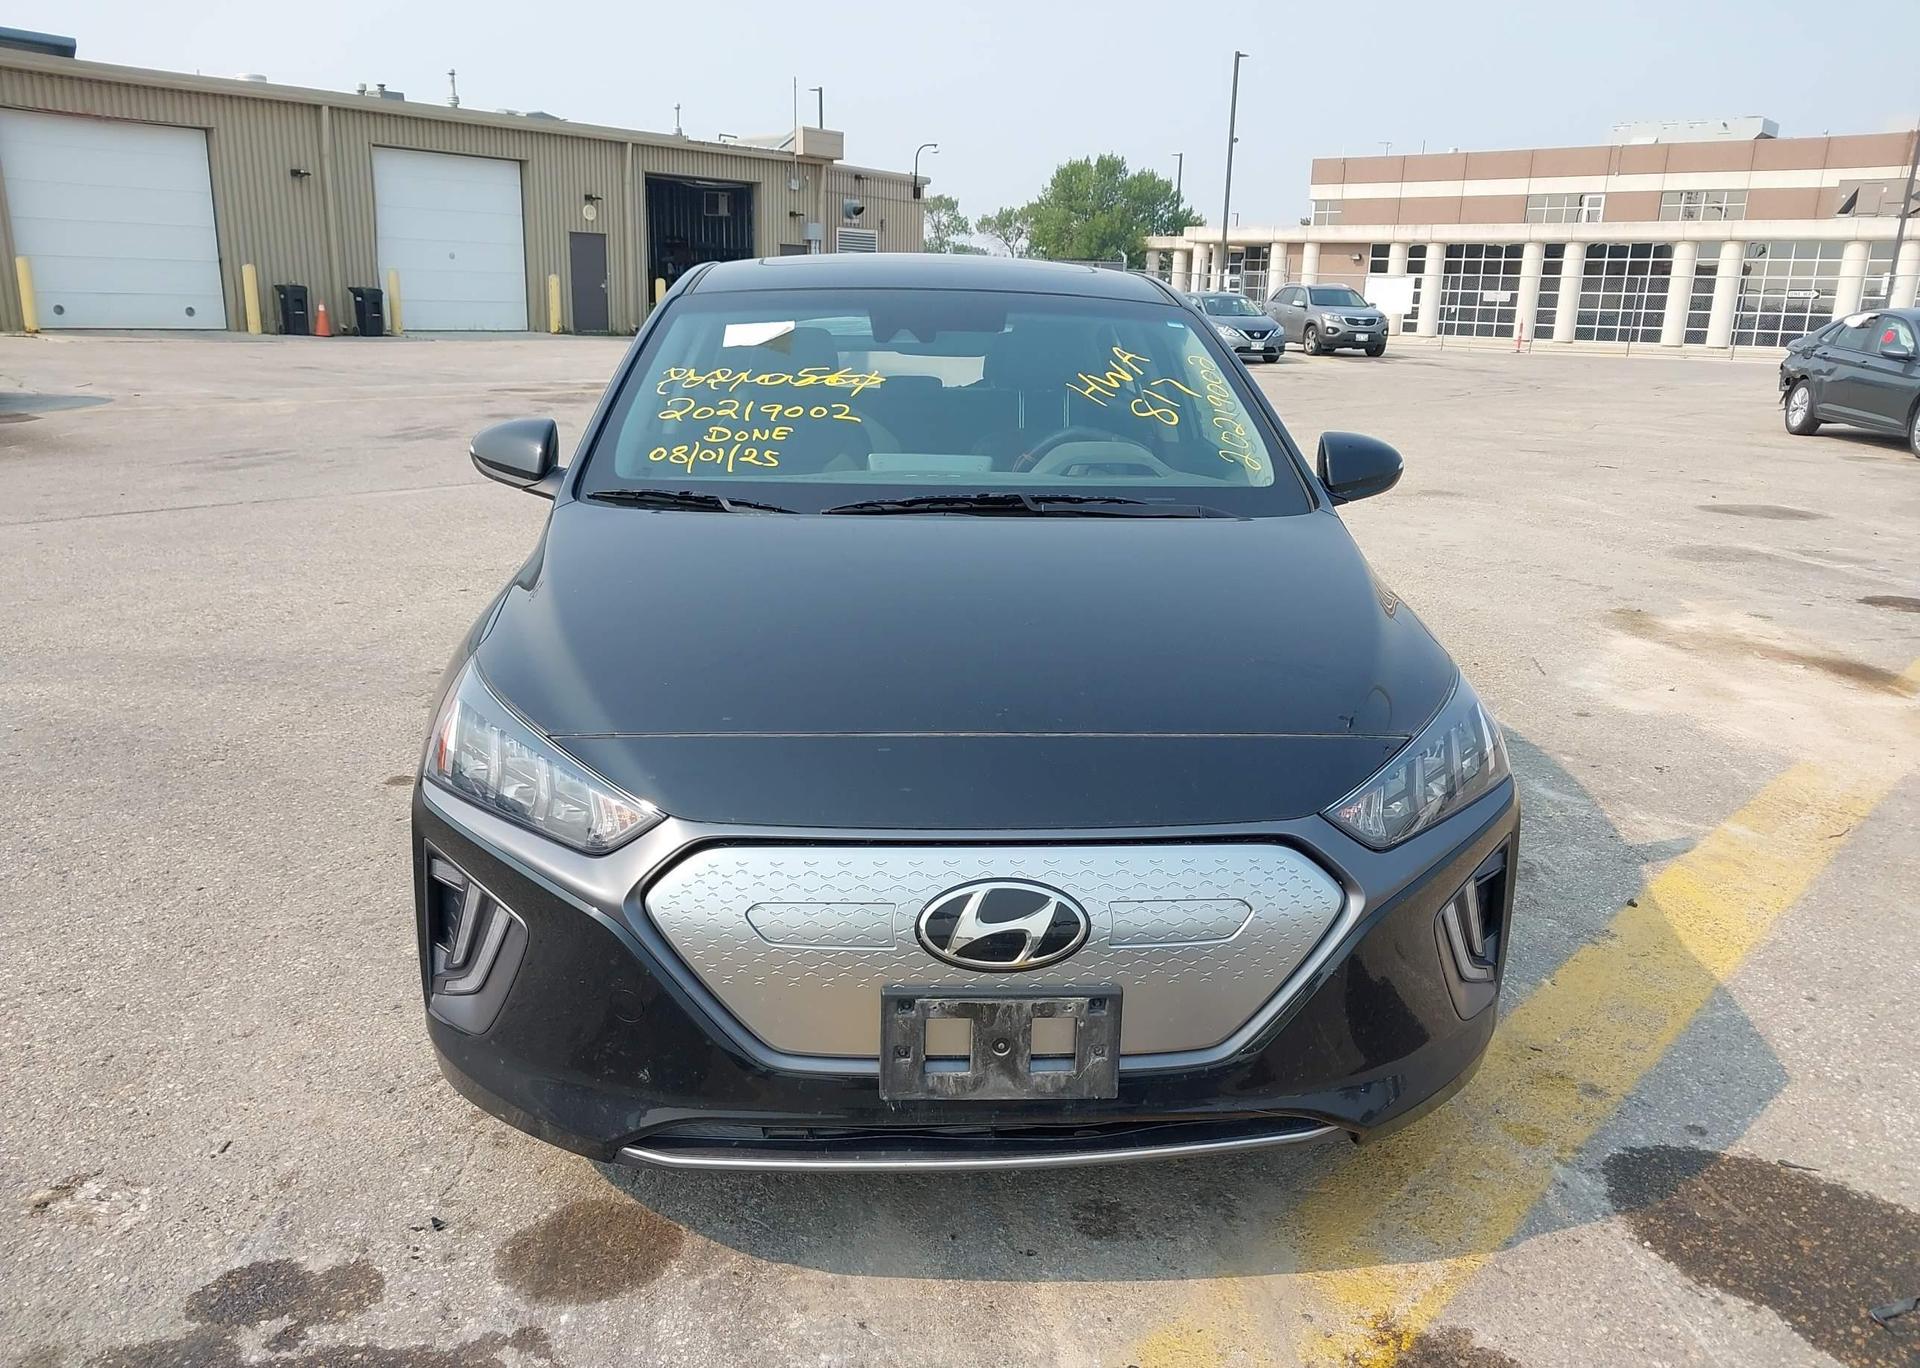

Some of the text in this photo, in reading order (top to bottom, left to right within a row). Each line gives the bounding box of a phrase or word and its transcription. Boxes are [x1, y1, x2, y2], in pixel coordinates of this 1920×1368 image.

[1065, 346, 1150, 407] HWA
[657, 398, 862, 423] 20219002
[1131, 378, 1202, 426] 817
[703, 426, 794, 443] DONE
[649, 441, 780, 473] 08/01/25
